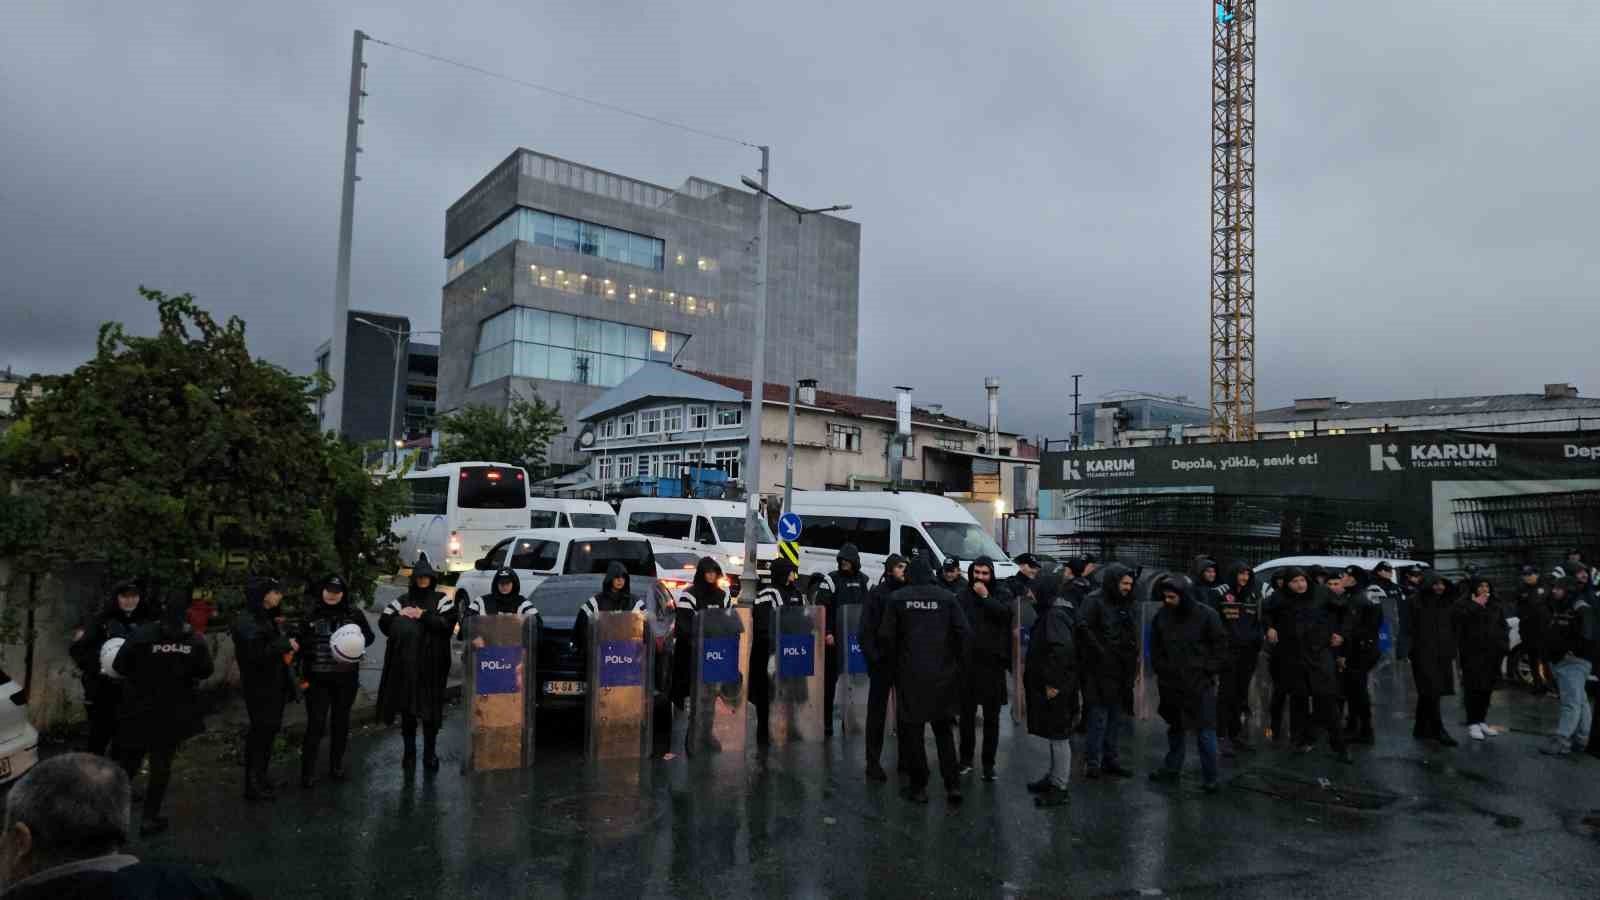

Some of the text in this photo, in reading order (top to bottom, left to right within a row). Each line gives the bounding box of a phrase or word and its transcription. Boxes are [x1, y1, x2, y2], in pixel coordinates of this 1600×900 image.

[1411, 443, 1496, 460] KARUM
[1563, 444, 1600, 460] Dep
[1086, 459, 1135, 472] KARUM
[1171, 452, 1318, 471] Depola, yükle, sevk et!
